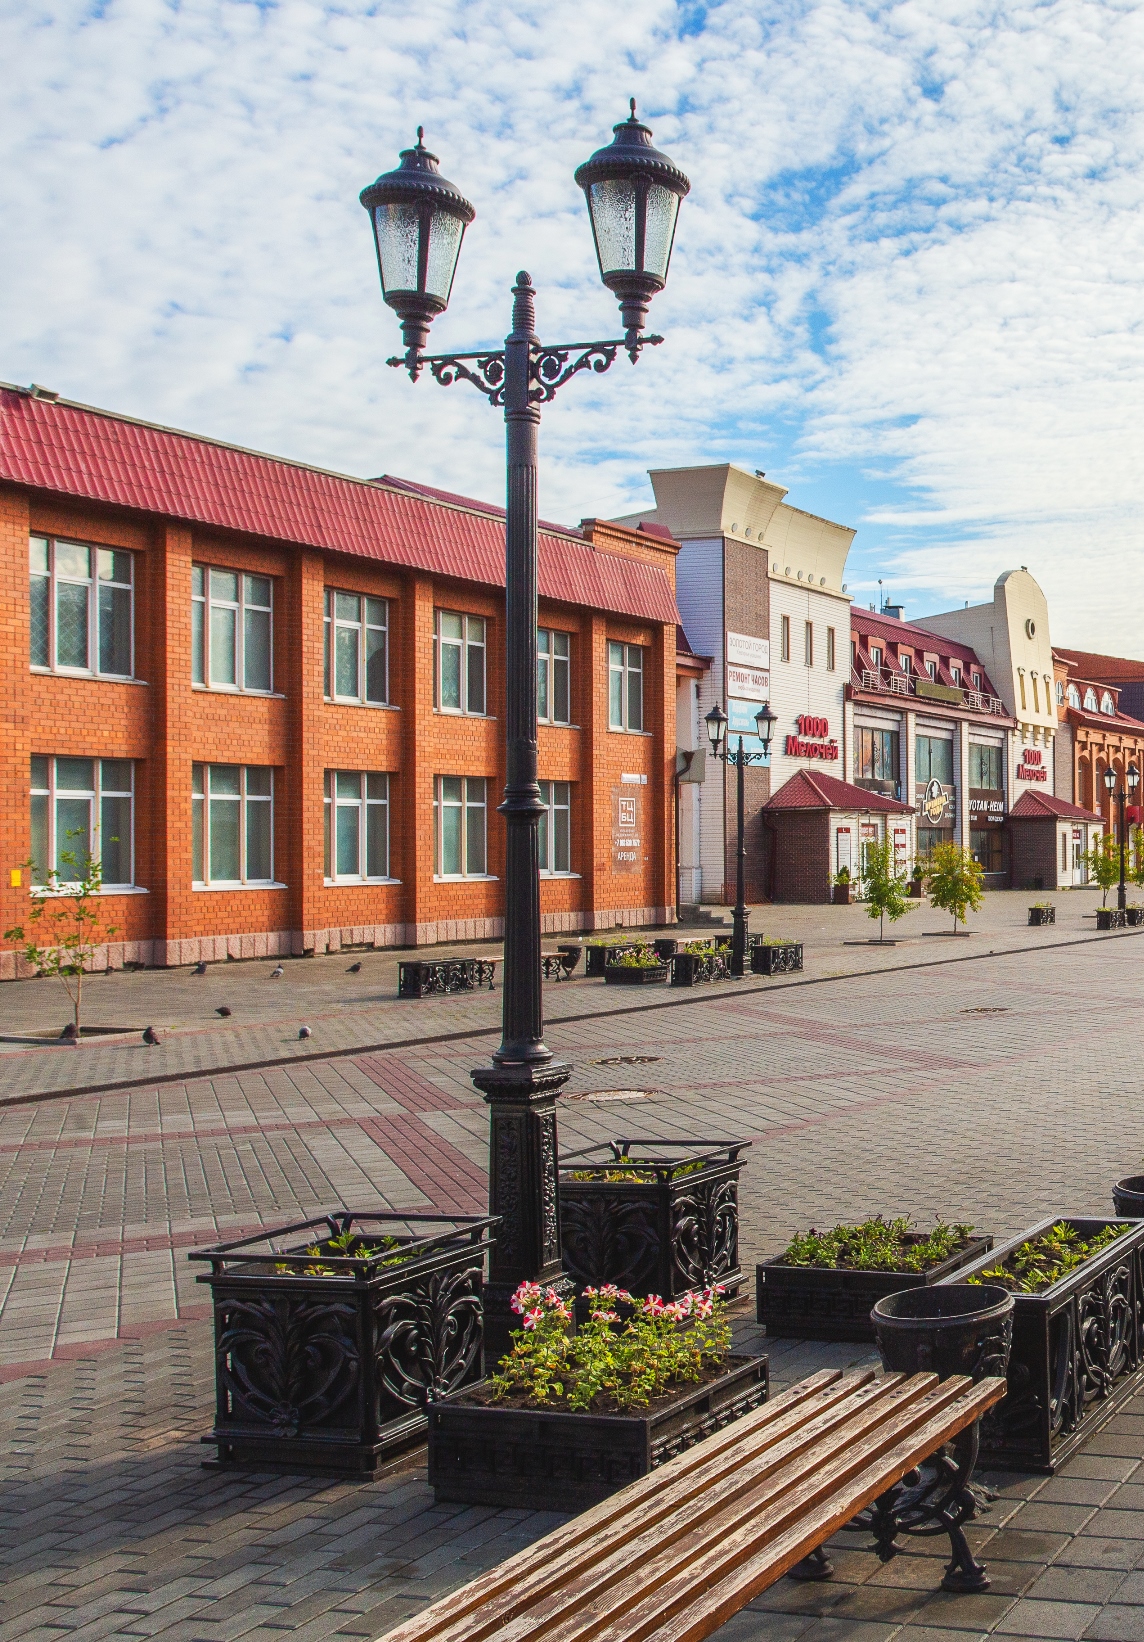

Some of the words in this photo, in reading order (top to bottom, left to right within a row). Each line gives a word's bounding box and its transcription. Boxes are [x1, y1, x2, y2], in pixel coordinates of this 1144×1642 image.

[729, 637, 752, 651] ЗОЛОТОЙ
[752, 642, 768, 655] ГОРОД
[729, 670, 750, 685] РЕМОНТ
[751, 673, 769, 687] ЧАСОВ
[796, 714, 828, 738] 1000
[785, 735, 838, 760] Мелочей
[1023, 749, 1042, 765] 1000
[1016, 764, 1047, 781] Мелочей
[620, 801, 634, 812] ТЦ
[621, 812, 634, 823] БЦ
[617, 851, 637, 862] АРЕНДА
